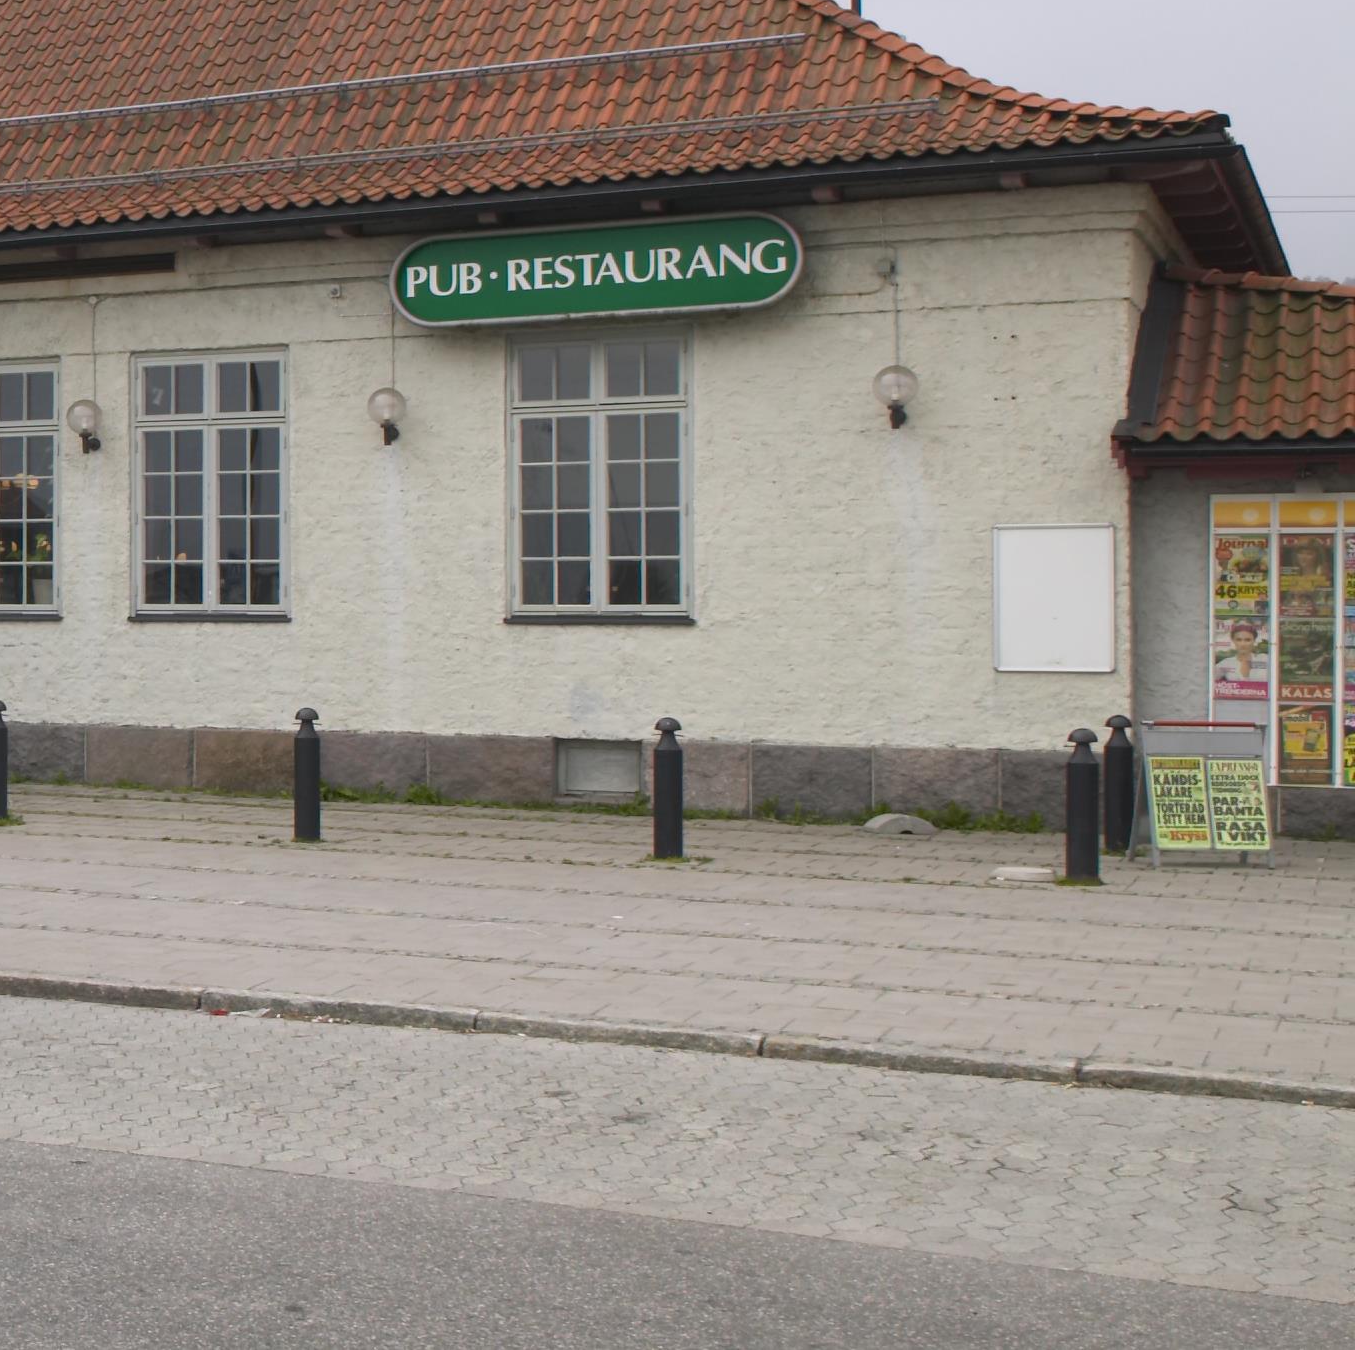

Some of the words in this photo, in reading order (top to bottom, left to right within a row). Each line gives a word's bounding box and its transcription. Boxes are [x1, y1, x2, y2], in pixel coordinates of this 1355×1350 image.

[406, 262, 482, 298] PUB
[506, 239, 787, 292] RESTAURANG
[1215, 585, 1237, 599] 46
[1281, 688, 1332, 698] KALAS
[1214, 806, 1264, 816] BANTA
[1216, 821, 1266, 831] RASA
[1227, 832, 1267, 841] VIKT
